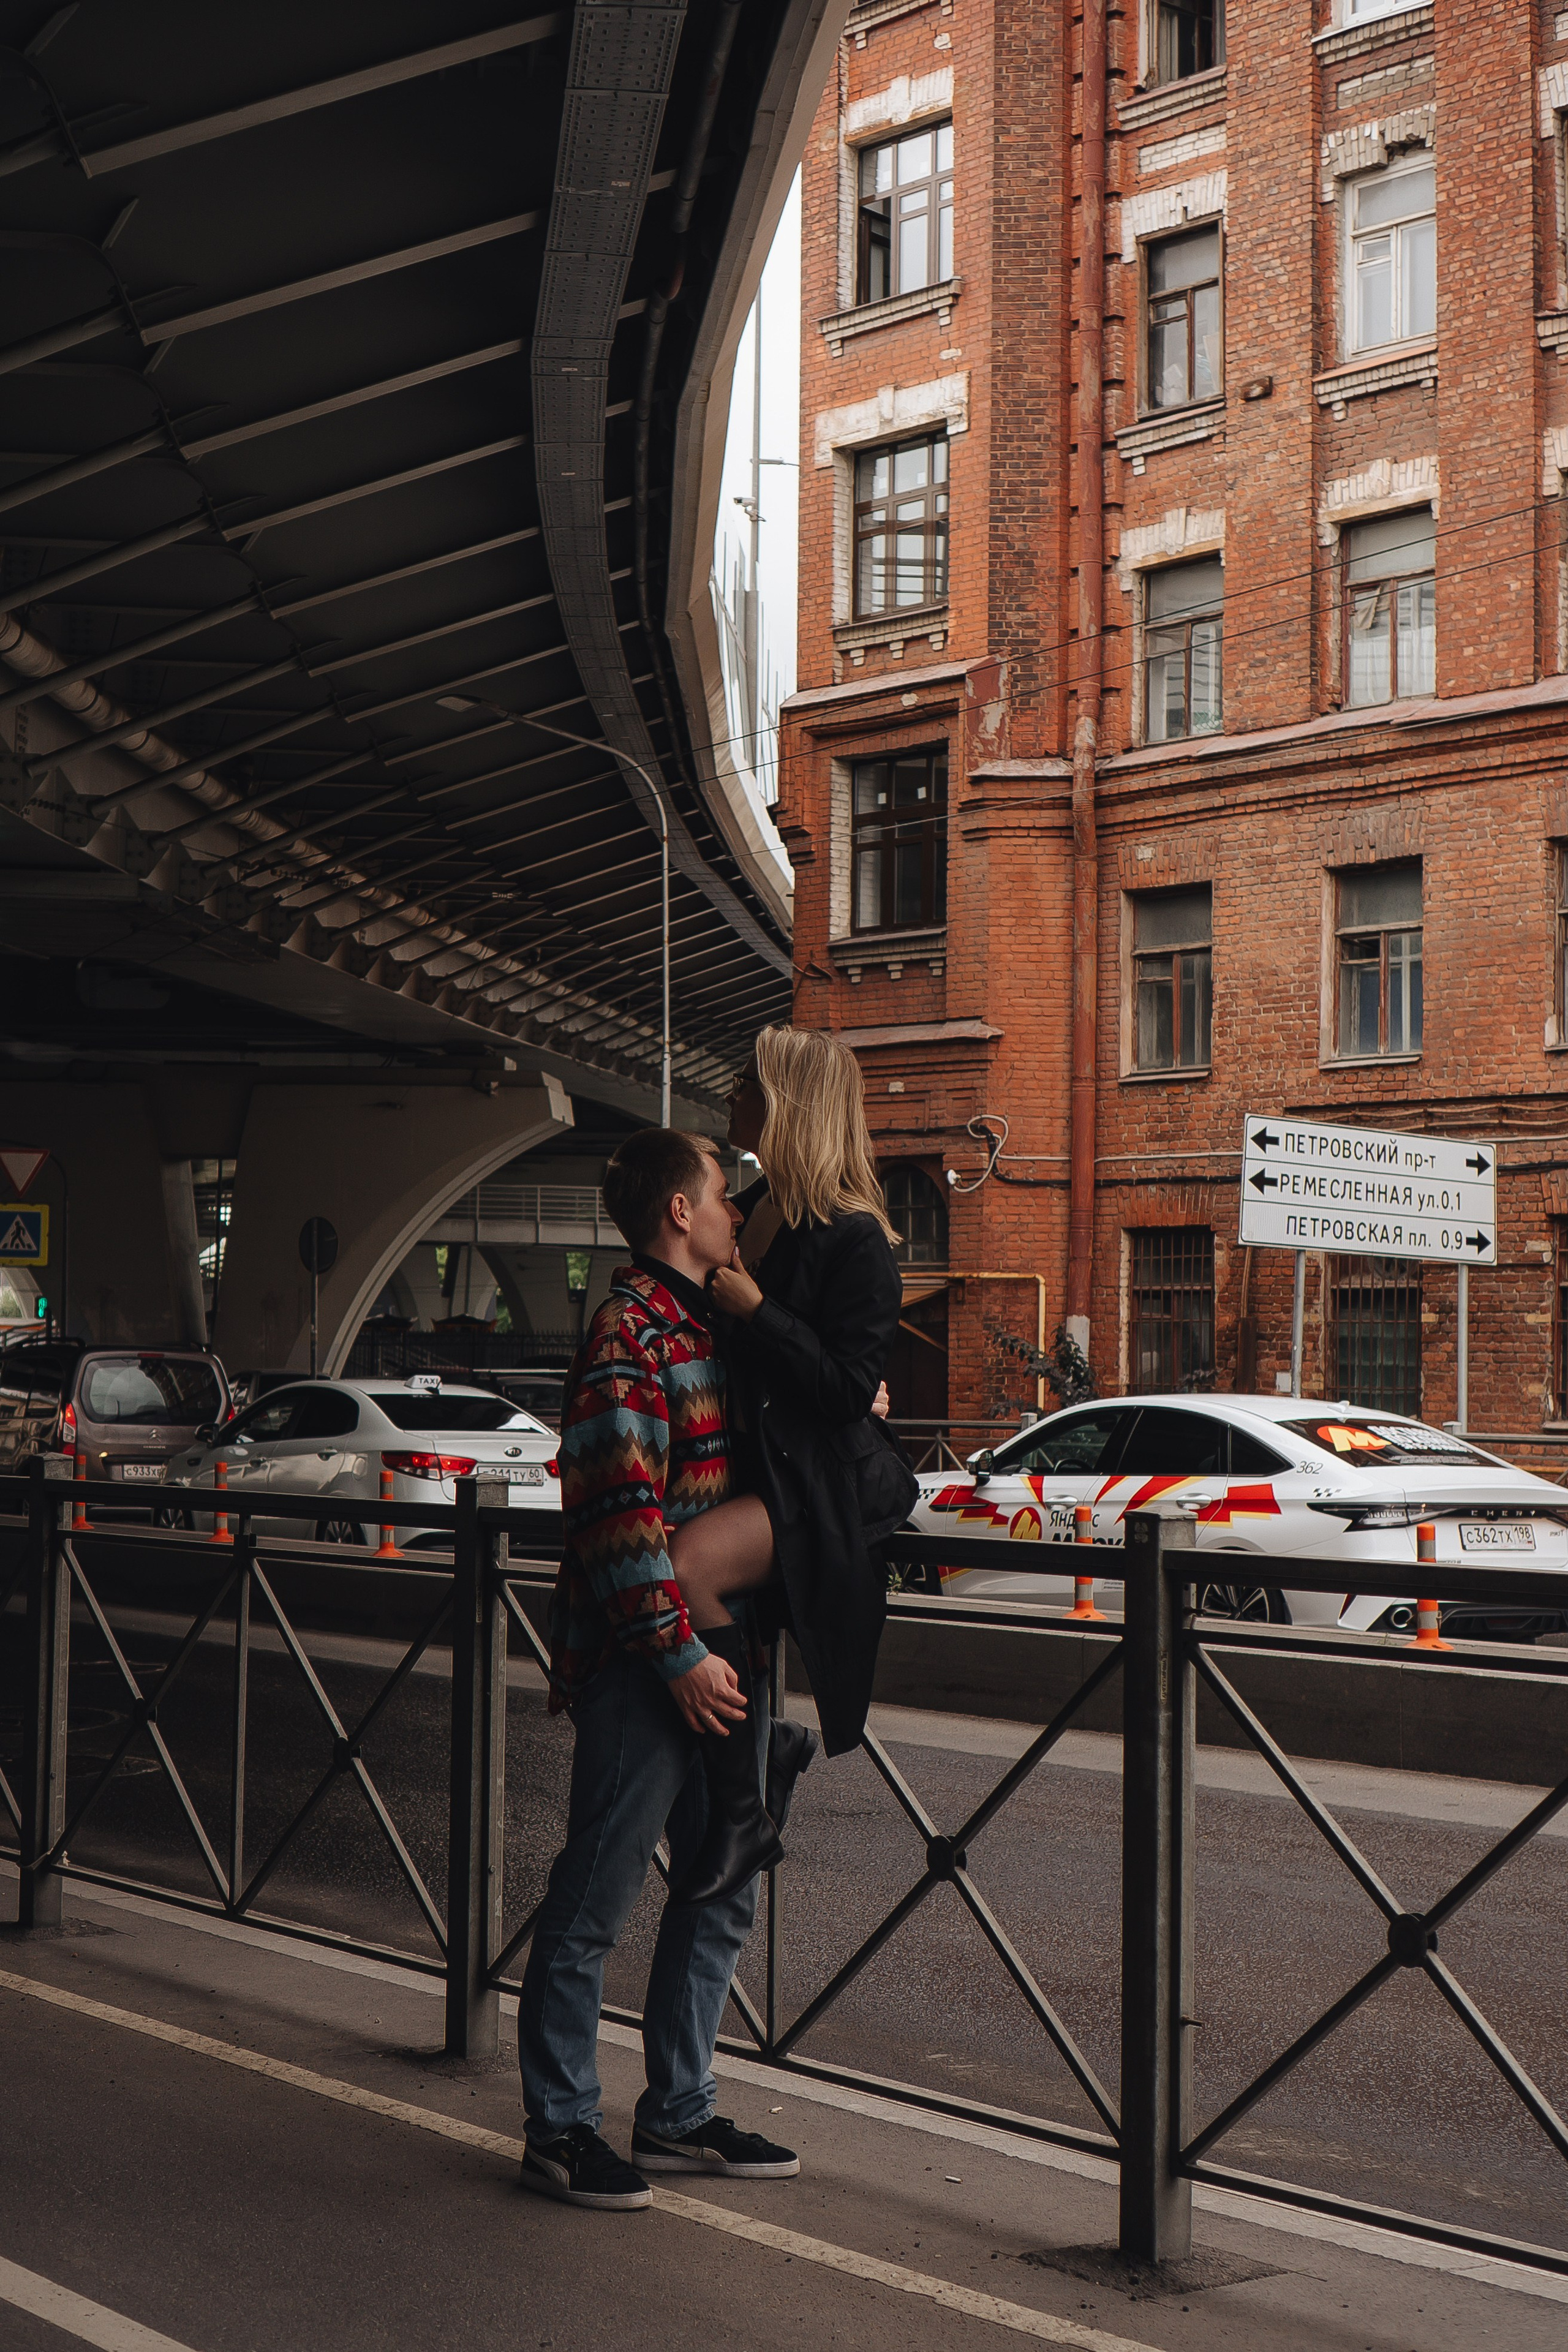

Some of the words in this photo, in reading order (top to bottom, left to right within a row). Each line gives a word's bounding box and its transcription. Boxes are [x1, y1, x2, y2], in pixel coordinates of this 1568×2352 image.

[1285, 1133, 1398, 1164] ПЕТРОВСКИЙ
[1405, 1152, 1436, 1171] пр-т
[1280, 1174, 1412, 1205] РЕМЕСЛЕННАЯ
[1287, 1215, 1403, 1245] ПЕТРОВСКАЯ
[1409, 1232, 1431, 1247] пл.
[1441, 1229, 1463, 1252] 0,9
[1296, 1460, 1324, 1475] 362
[1049, 1510, 1101, 1530] Яндс
